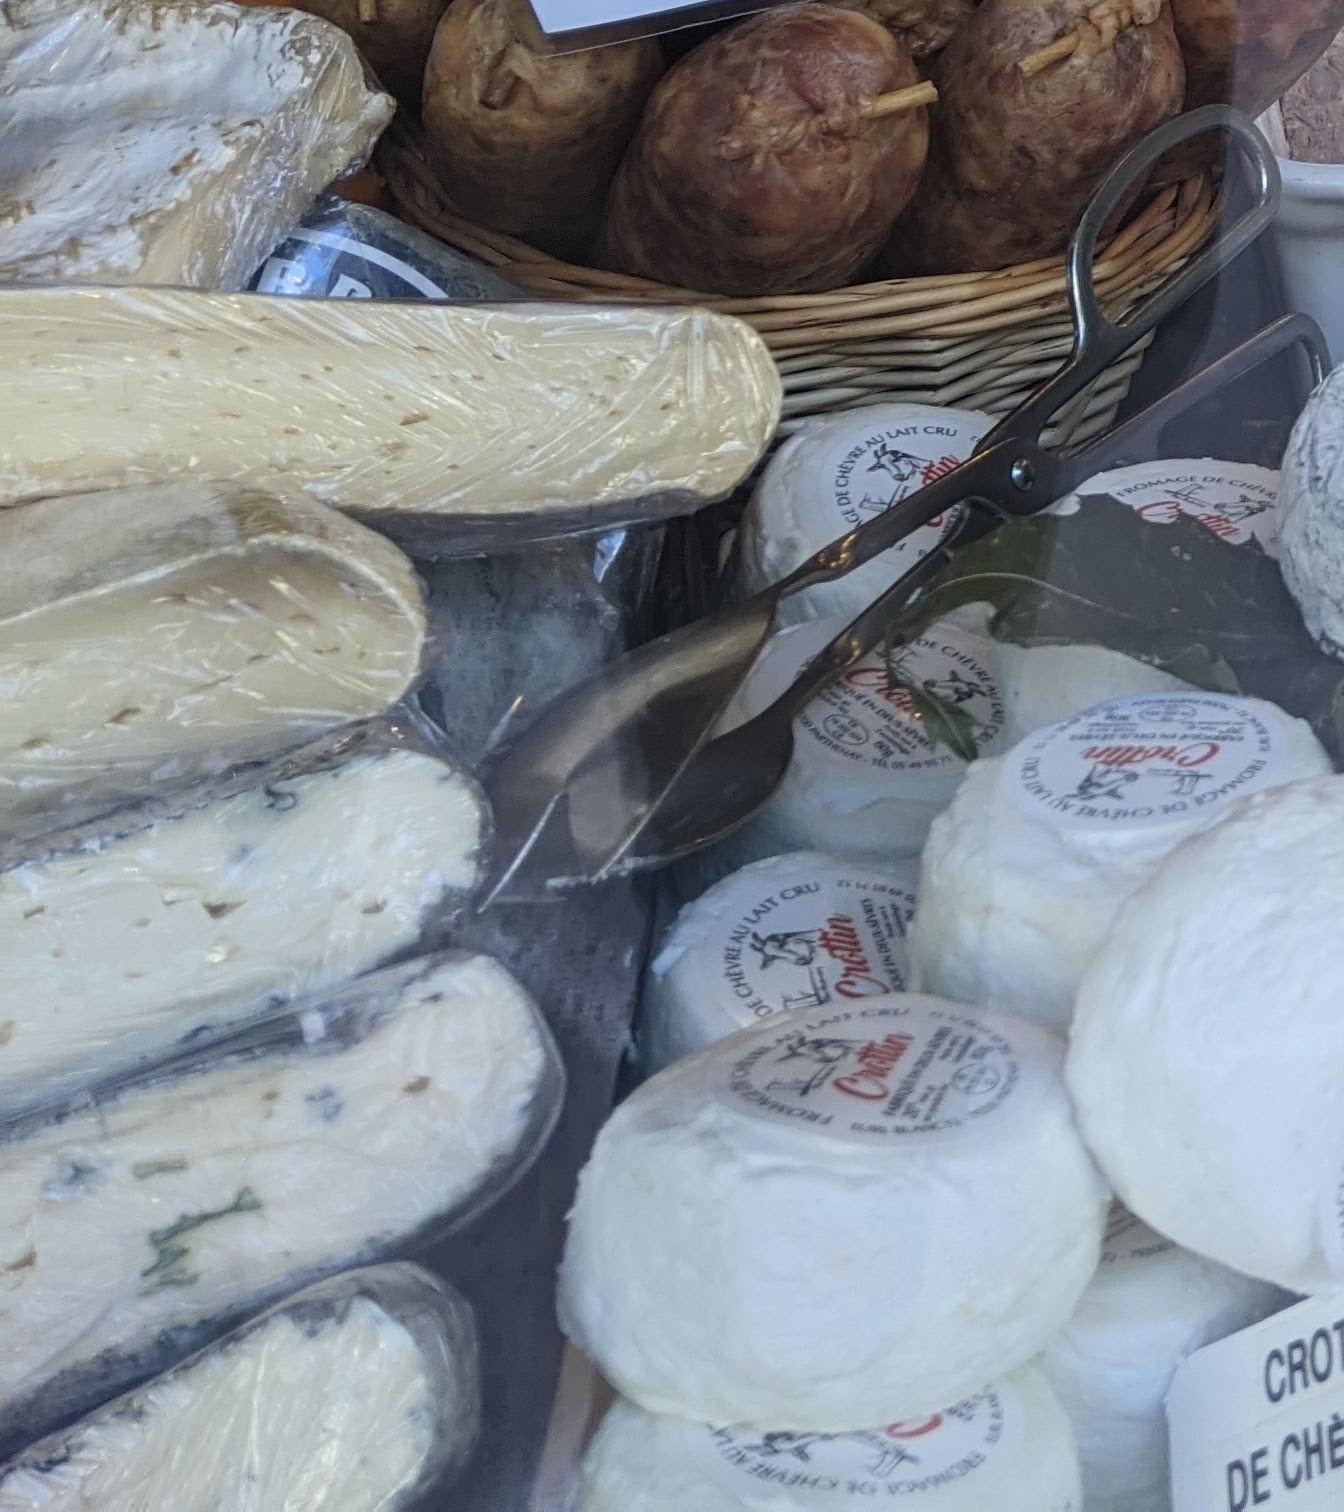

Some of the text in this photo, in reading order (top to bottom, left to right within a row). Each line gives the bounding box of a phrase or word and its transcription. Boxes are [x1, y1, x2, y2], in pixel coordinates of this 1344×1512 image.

[885, 425, 958, 439] LAIT CRU
[1115, 475, 1198, 497] FROMAGE
[1081, 741, 1221, 768] Crottin
[1161, 758, 1267, 814] FROMAGE DE
[743, 881, 821, 1018] DE LAIT CRU
[819, 912, 891, 999] Crottin
[833, 1031, 914, 1100] Crottin
[1226, 1446, 1272, 1512] DE
